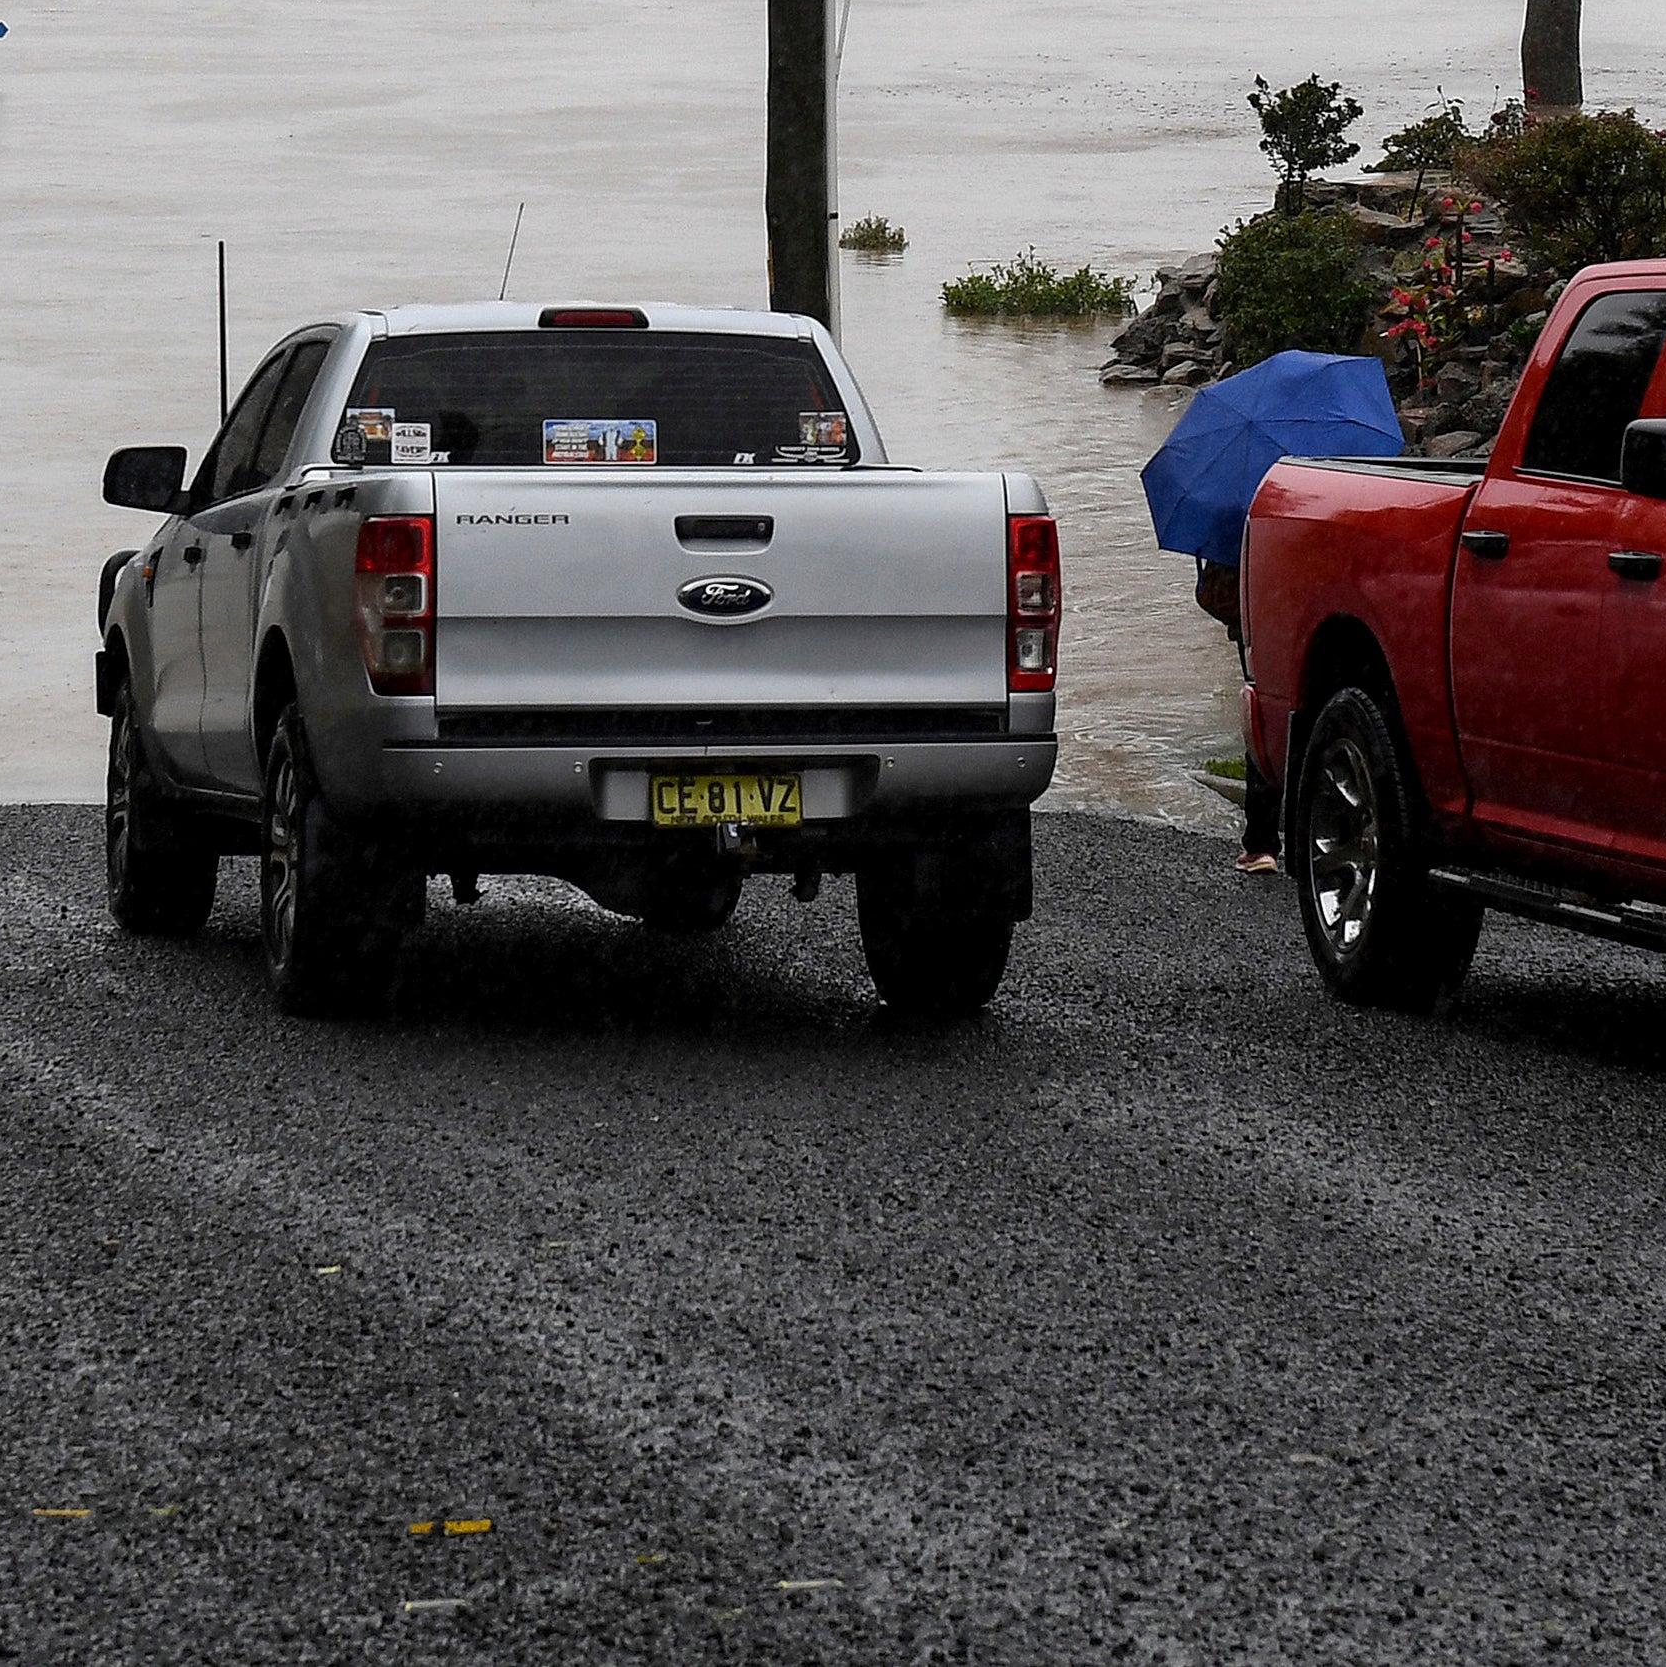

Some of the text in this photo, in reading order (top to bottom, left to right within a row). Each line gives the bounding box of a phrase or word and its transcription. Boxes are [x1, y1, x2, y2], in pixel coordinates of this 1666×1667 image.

[456, 514, 570, 525] RANGER
[701, 584, 751, 605] Ford
[746, 814, 785, 823] WALES
